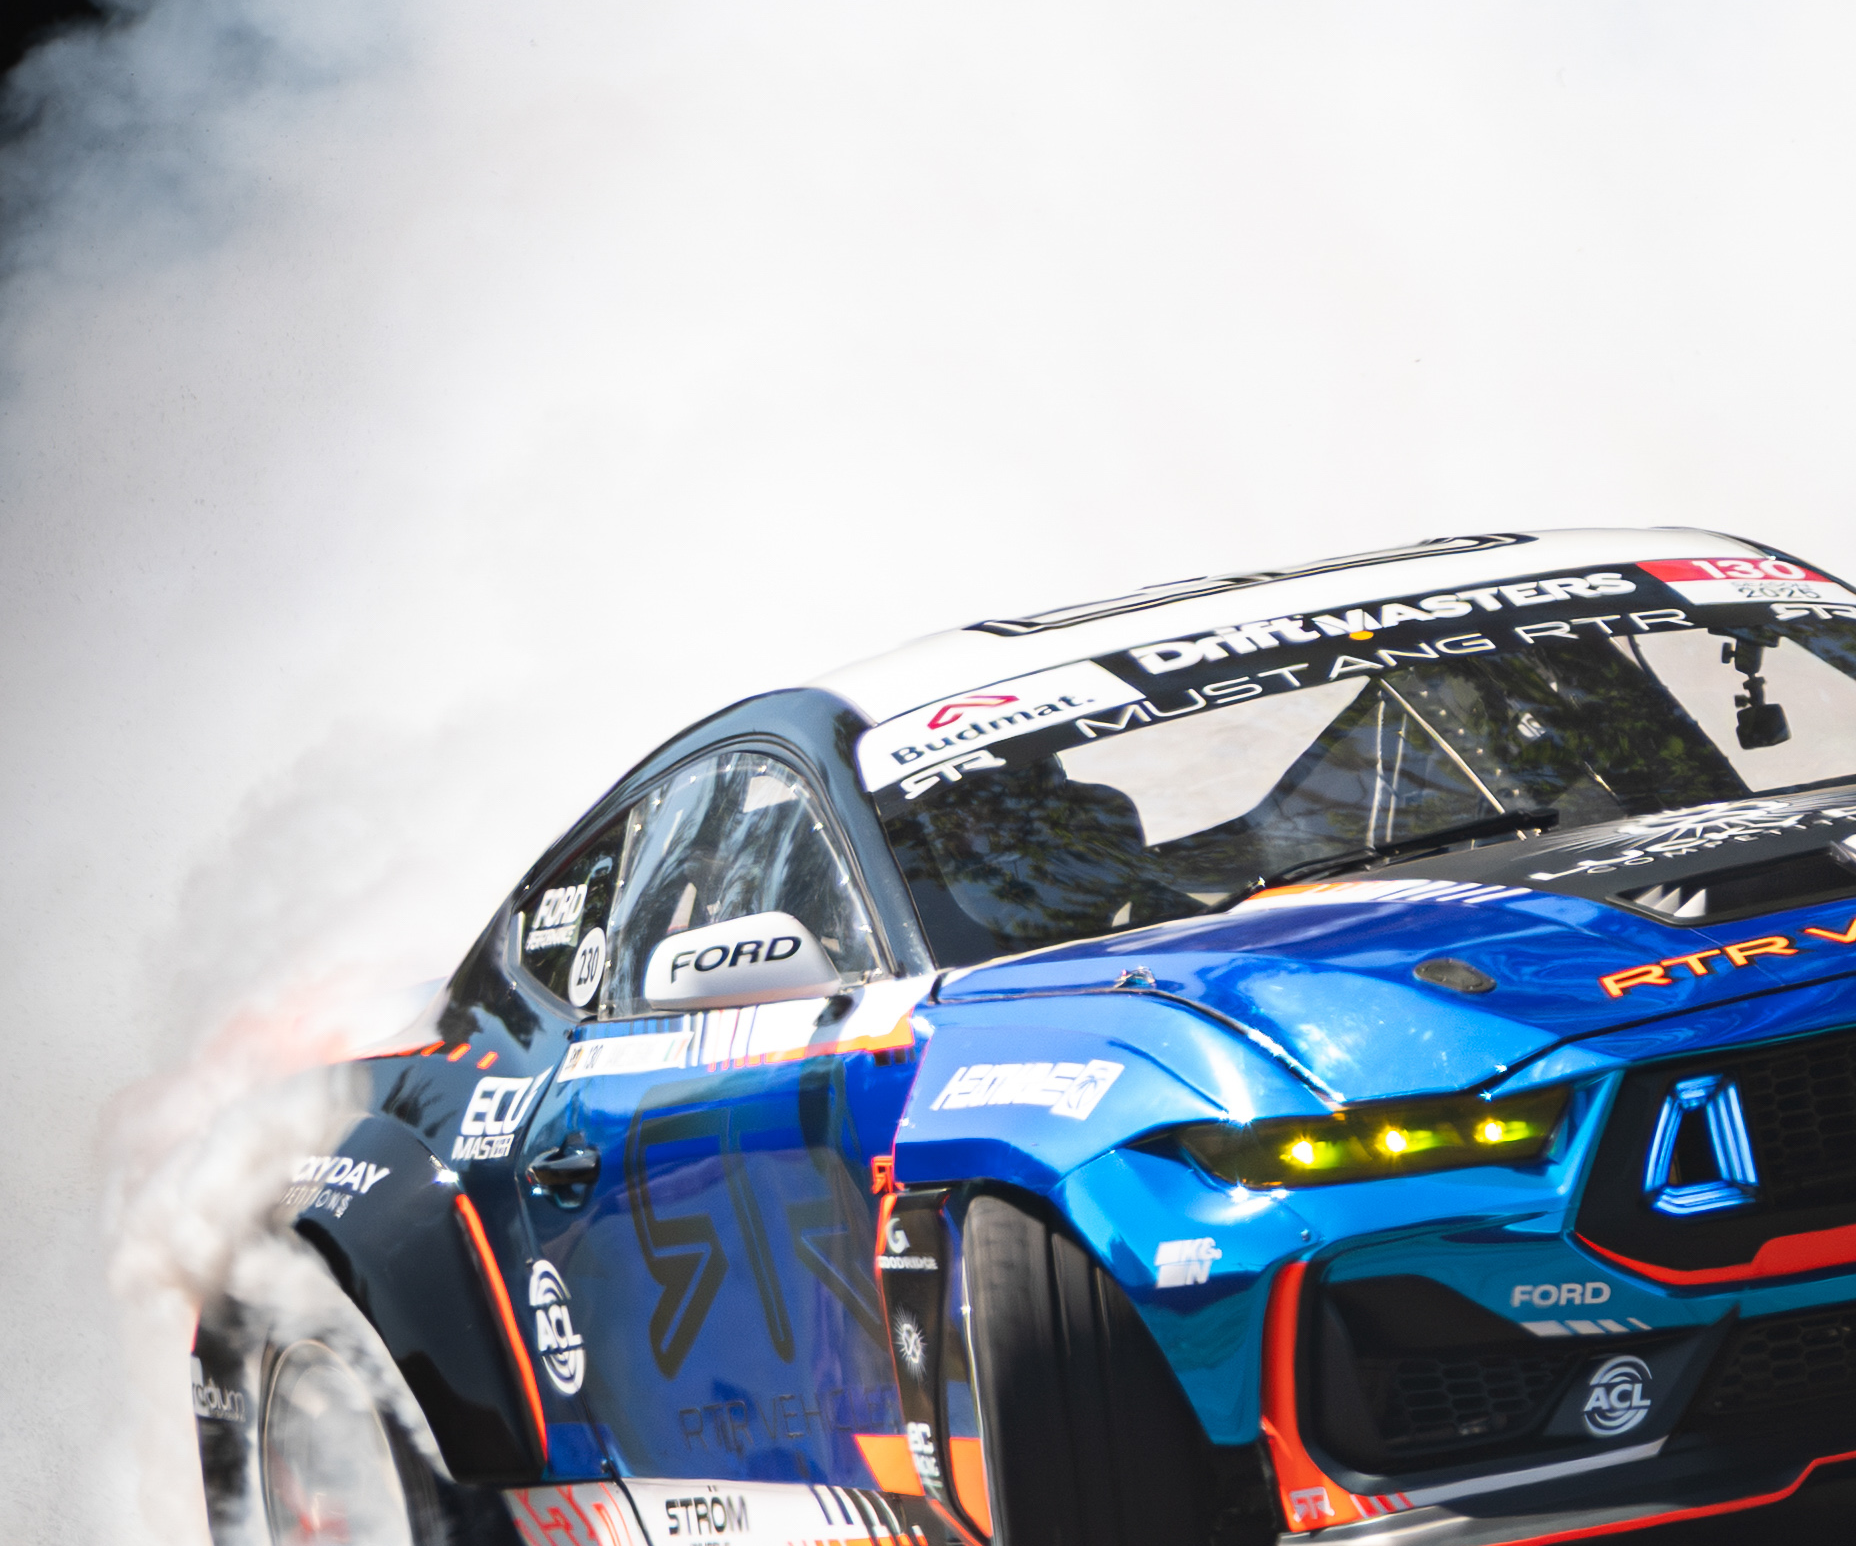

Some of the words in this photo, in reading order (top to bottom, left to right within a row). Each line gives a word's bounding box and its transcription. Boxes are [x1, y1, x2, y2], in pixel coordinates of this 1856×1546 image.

[1690, 559, 1806, 580] 130
[1073, 631, 1497, 739] MUSTANG
[1513, 607, 1696, 645] RTR
[532, 883, 588, 929] FORD
[576, 944, 600, 987] 230
[671, 935, 803, 985] FORD
[1600, 934, 1801, 1001] RTR
[1510, 1282, 1612, 1308] FORD
[535, 1303, 583, 1352] ACL
[1583, 1385, 1652, 1413] ACL
[665, 1485, 750, 1536] STRÖM
